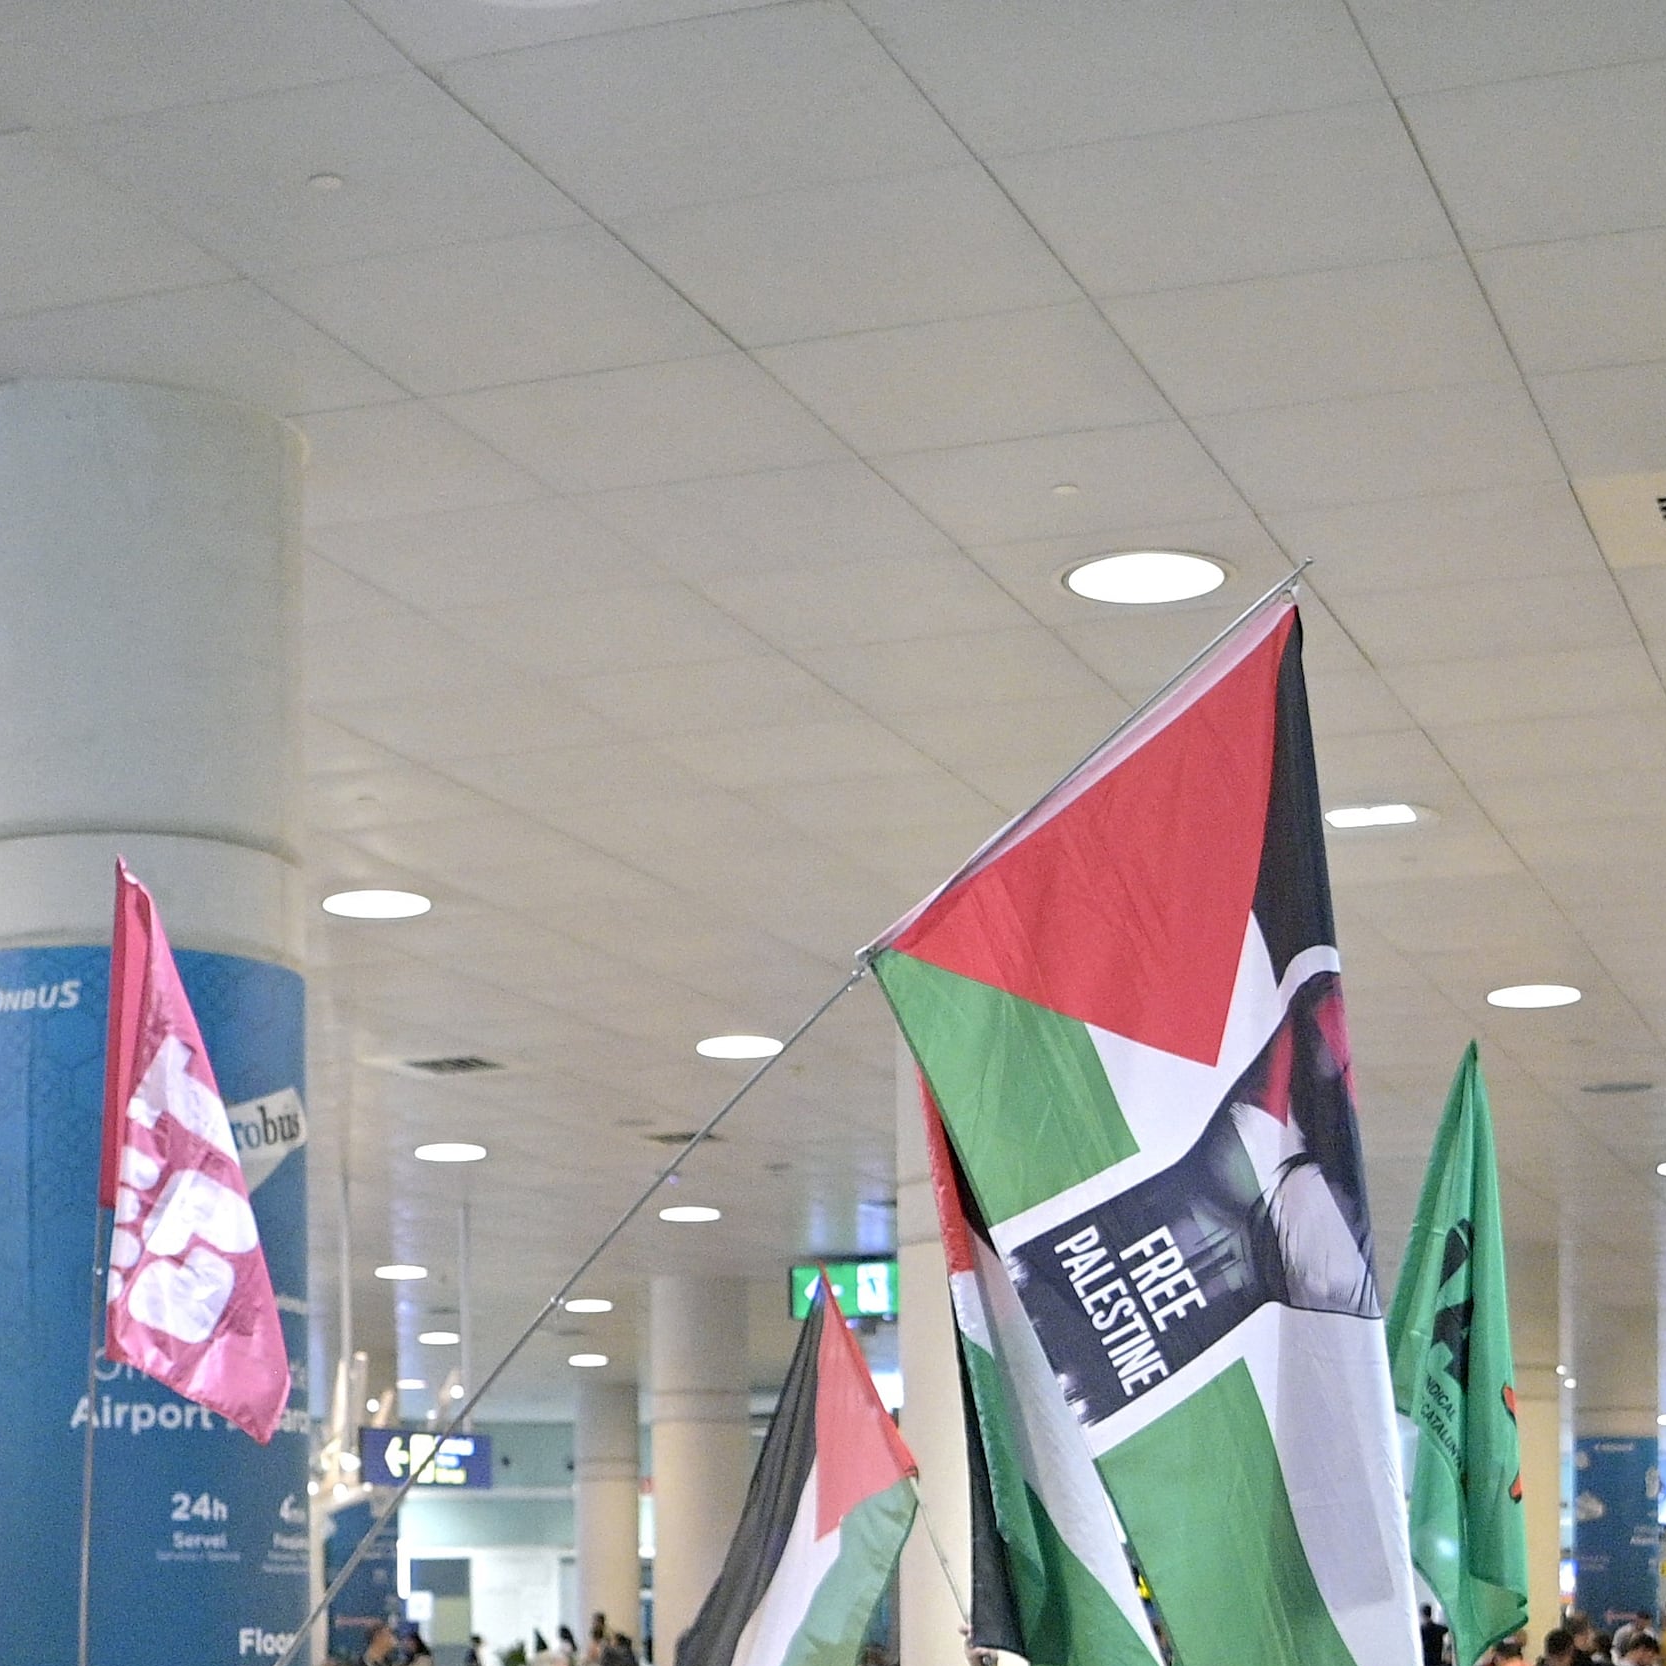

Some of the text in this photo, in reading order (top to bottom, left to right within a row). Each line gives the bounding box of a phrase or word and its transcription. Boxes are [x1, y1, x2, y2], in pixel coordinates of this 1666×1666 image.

[1054, 1224, 1169, 1396] PALESTINE
[1119, 1225, 1206, 1332] FREE
[70, 1396, 214, 1436] Airport
[171, 1491, 229, 1522] 24h
